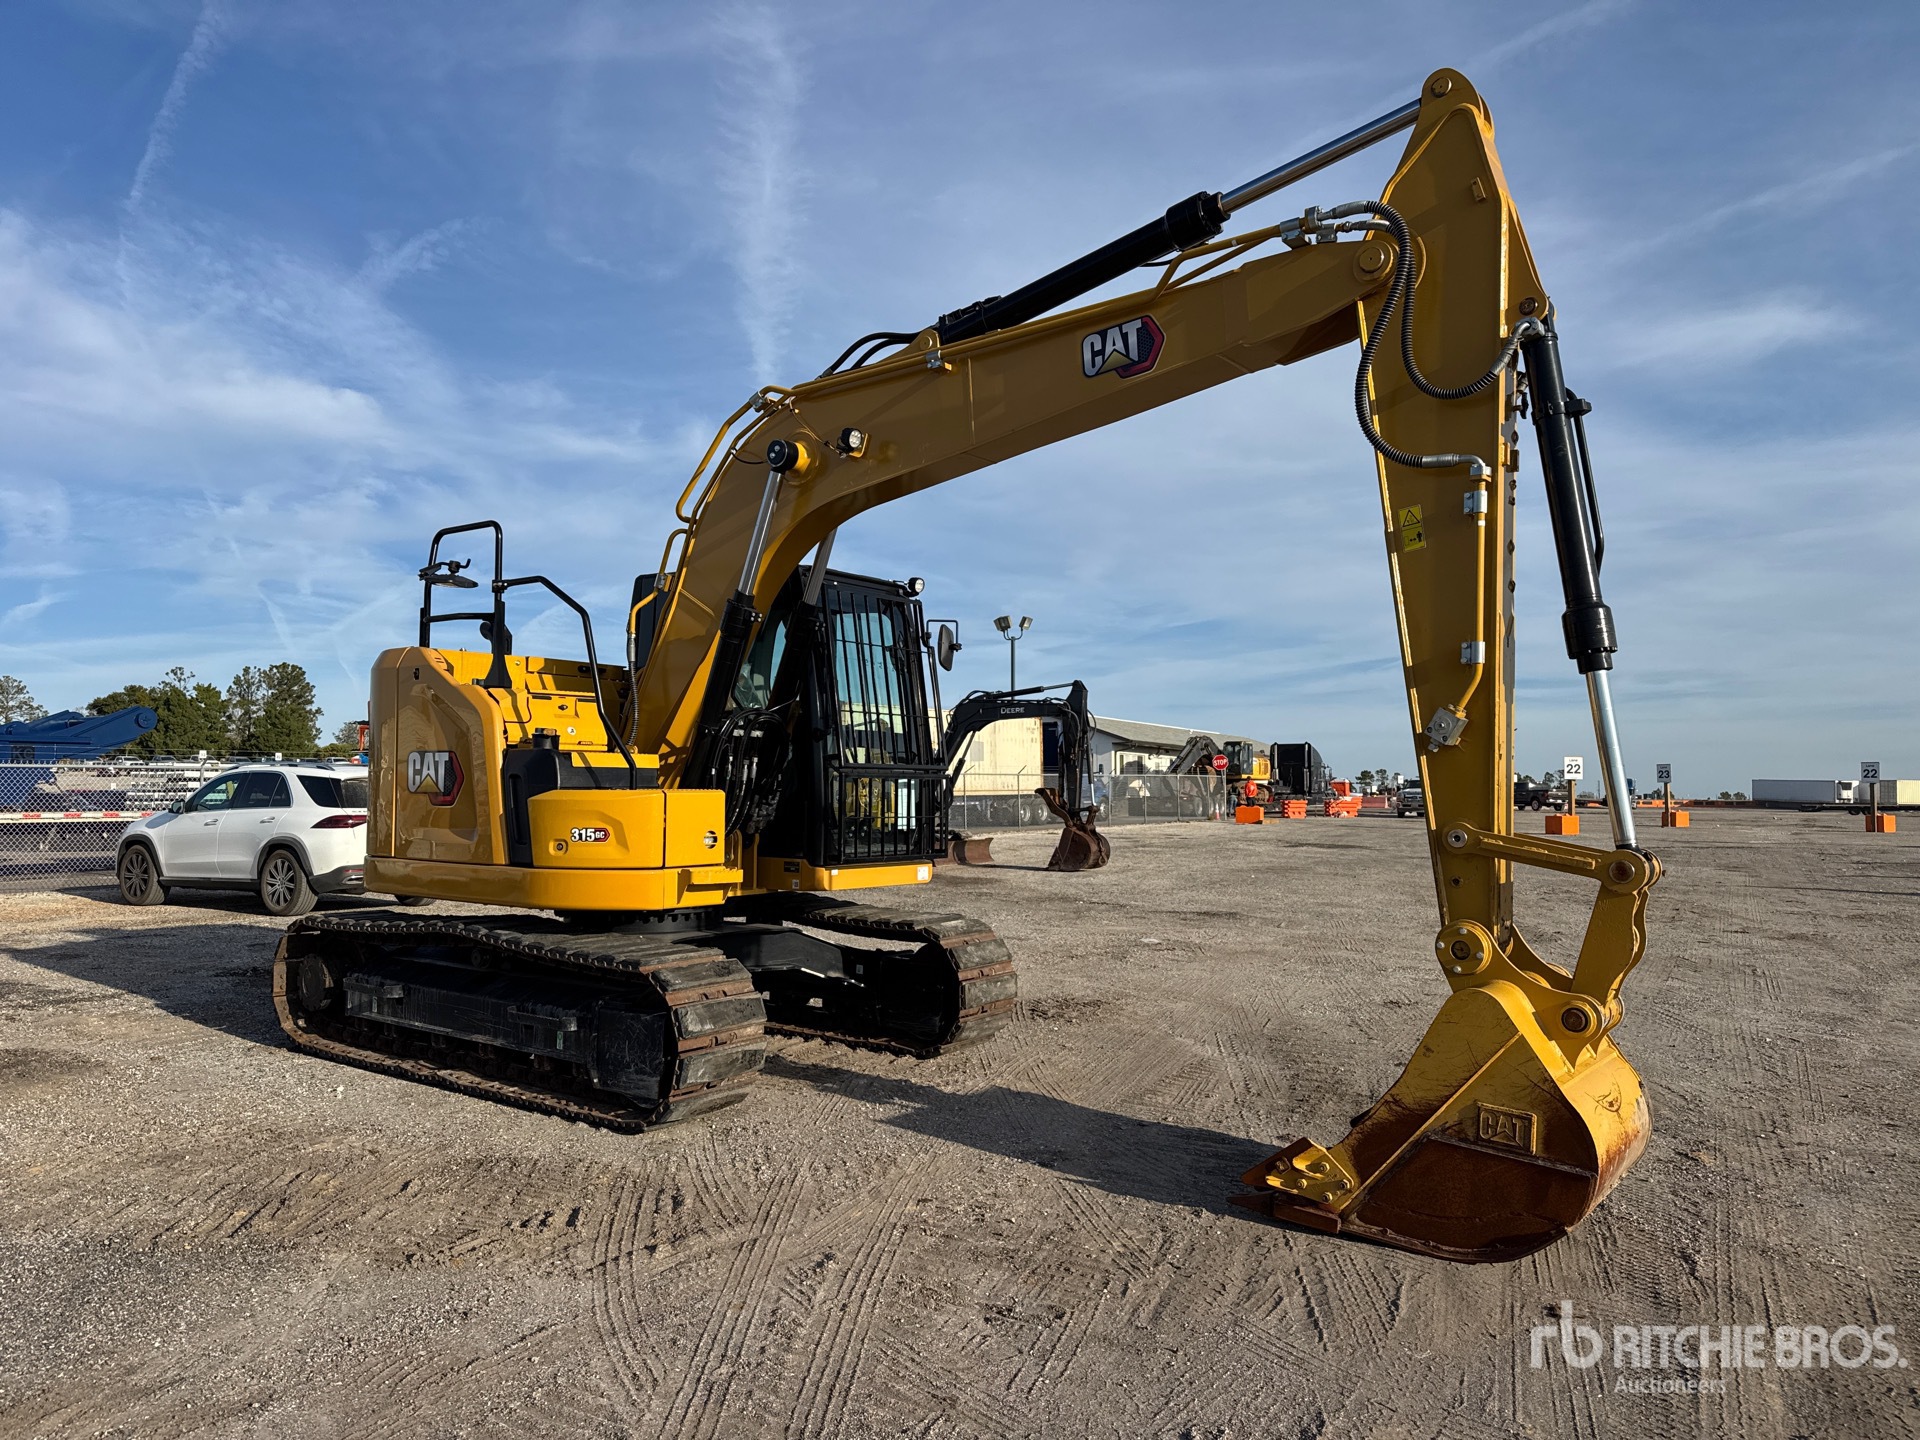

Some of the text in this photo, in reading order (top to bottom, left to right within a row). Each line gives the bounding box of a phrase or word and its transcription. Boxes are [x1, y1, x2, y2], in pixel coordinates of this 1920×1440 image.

[1082, 318, 1142, 377] CAT
[1000, 706, 1026, 715] DEERE
[1213, 759, 1228, 767] STOP
[1566, 763, 1581, 774] 22
[407, 751, 450, 793] CAT
[1658, 769, 1670, 779] 23
[1862, 768, 1878, 779] 22
[571, 828, 595, 842] 315
[1480, 1110, 1528, 1148] CAT
